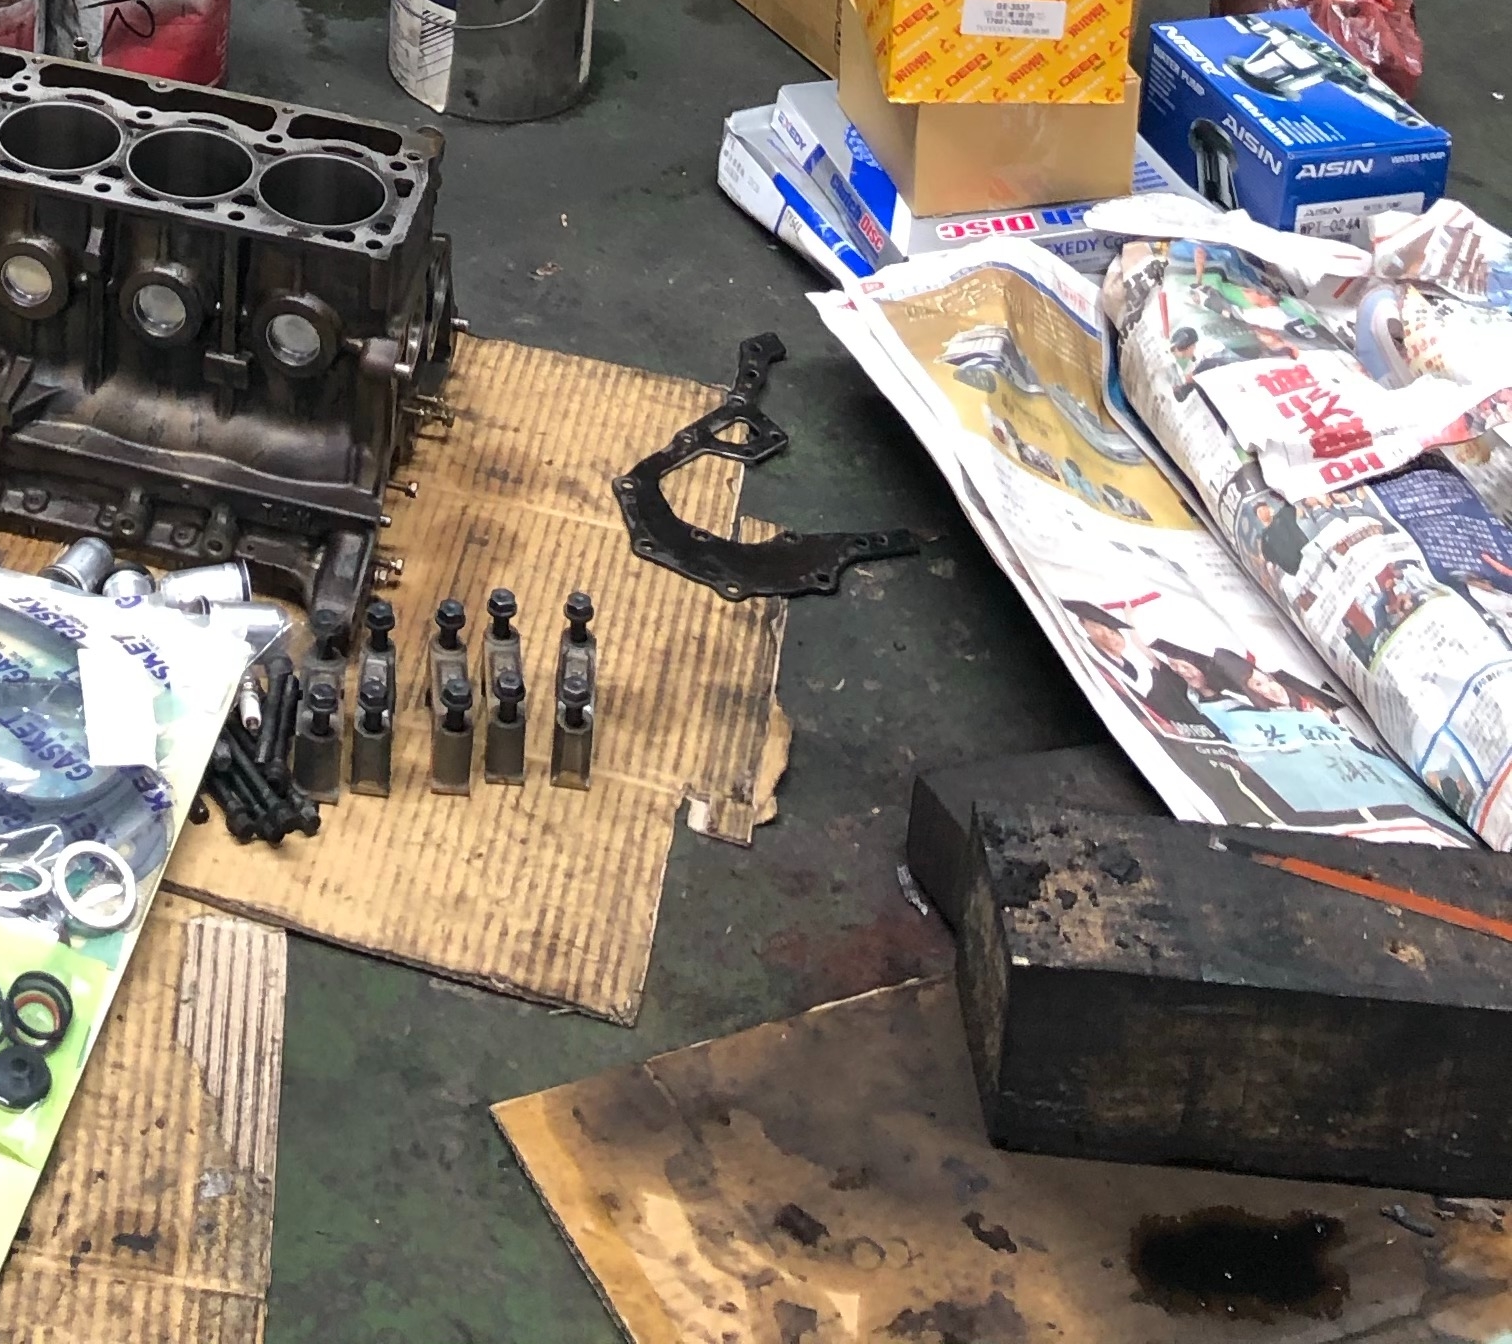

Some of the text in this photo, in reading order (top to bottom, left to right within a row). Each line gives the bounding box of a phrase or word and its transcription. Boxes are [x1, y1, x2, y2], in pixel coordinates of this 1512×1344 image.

[892, 2, 935, 36] DEER
[1159, 25, 1225, 77] AISIN
[945, 52, 988, 87] DEER
[1058, 52, 1101, 87] DEER
[778, 110, 807, 151] EXEDY
[1222, 113, 1283, 176] AISIN
[1295, 159, 1374, 179] AISIN
[1391, 152, 1446, 164] WATER PUMP
[859, 213, 885, 253] DISC
[938, 213, 1037, 240] DISC
[111, 633, 173, 691] SKET
